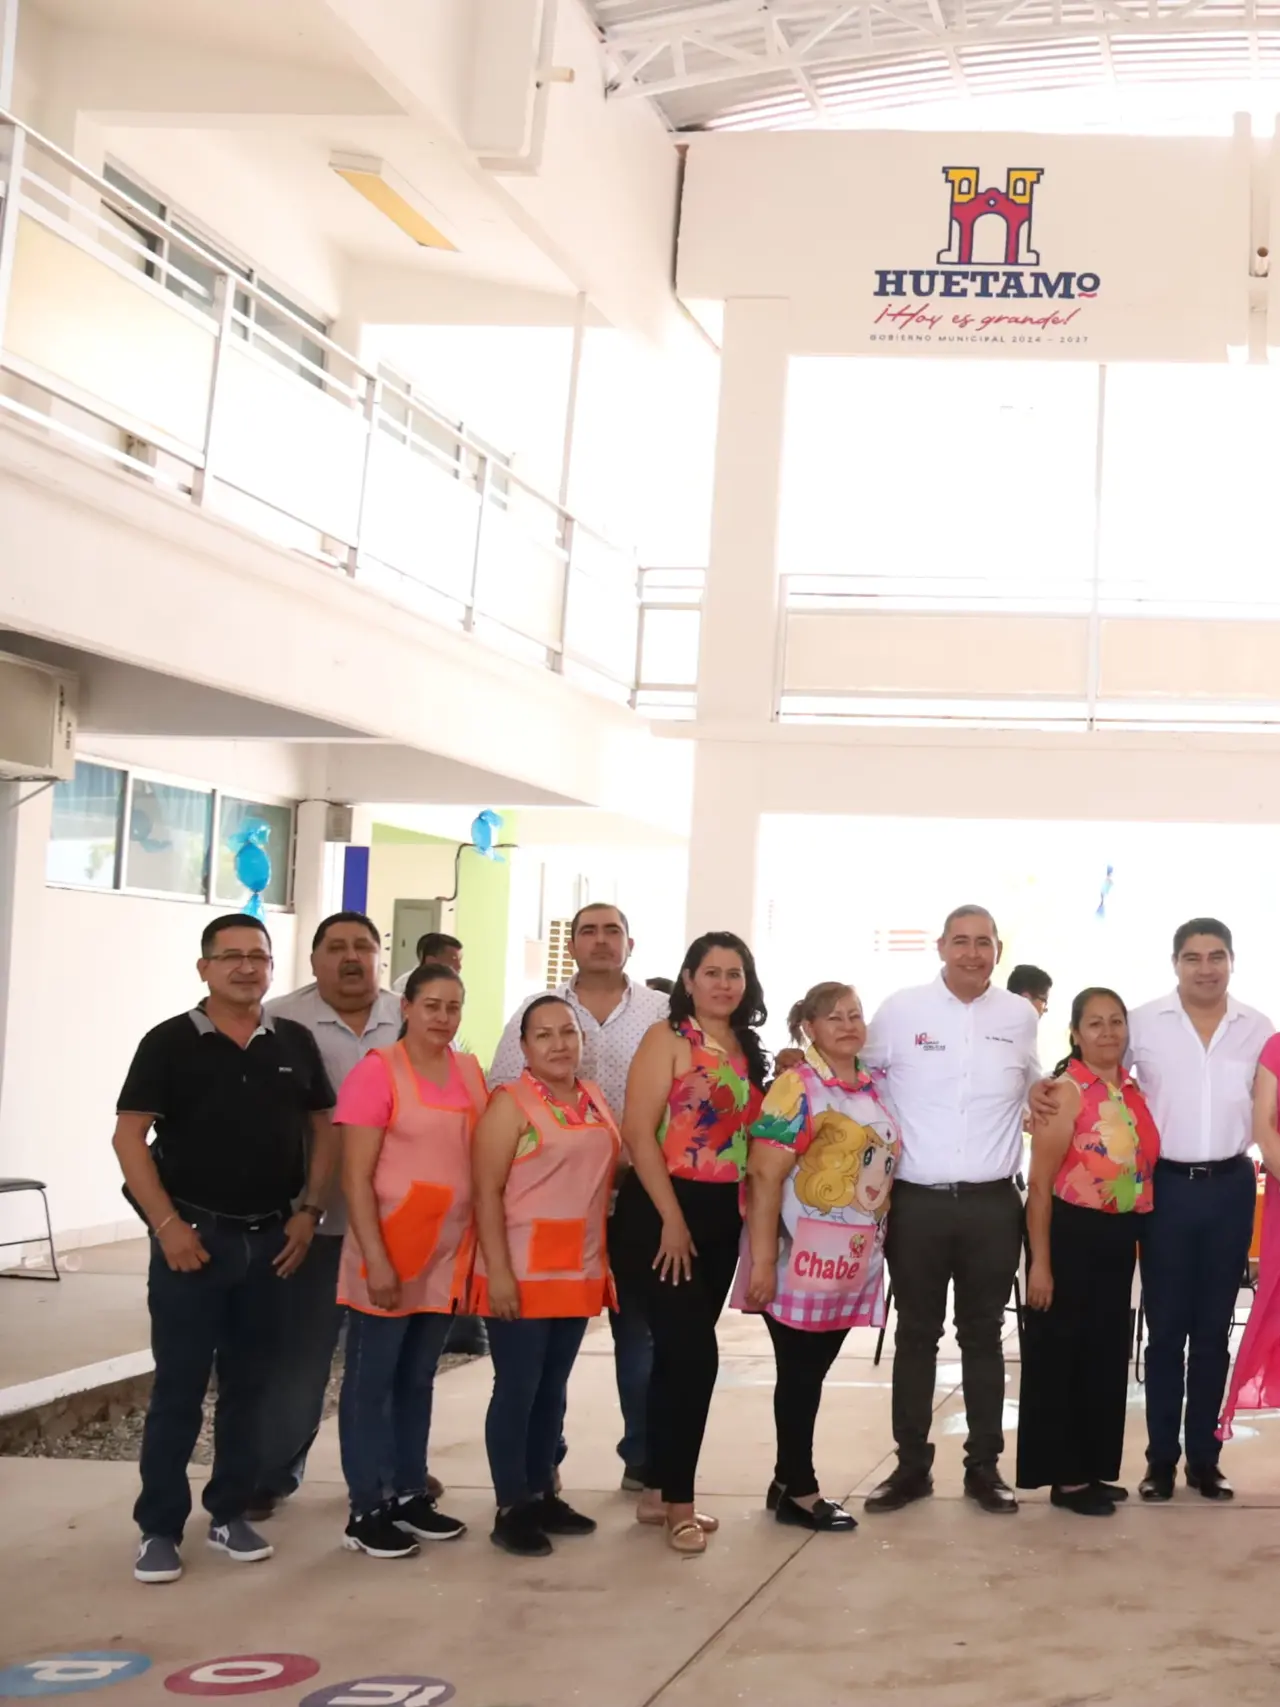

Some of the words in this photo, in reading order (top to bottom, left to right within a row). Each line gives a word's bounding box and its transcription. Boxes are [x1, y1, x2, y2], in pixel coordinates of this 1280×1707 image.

[873, 269, 1101, 299] HUETAMO
[873, 302, 943, 331] ¡Hoy
[951, 312, 975, 329] es
[975, 307, 1082, 332] grande!
[869, 333, 932, 342] GOBIERNO
[938, 335, 1005, 343] MUNICIPAL
[1012, 336, 1042, 344] 2024
[1059, 336, 1089, 344] 2027
[794, 1250, 861, 1280] Chabe
